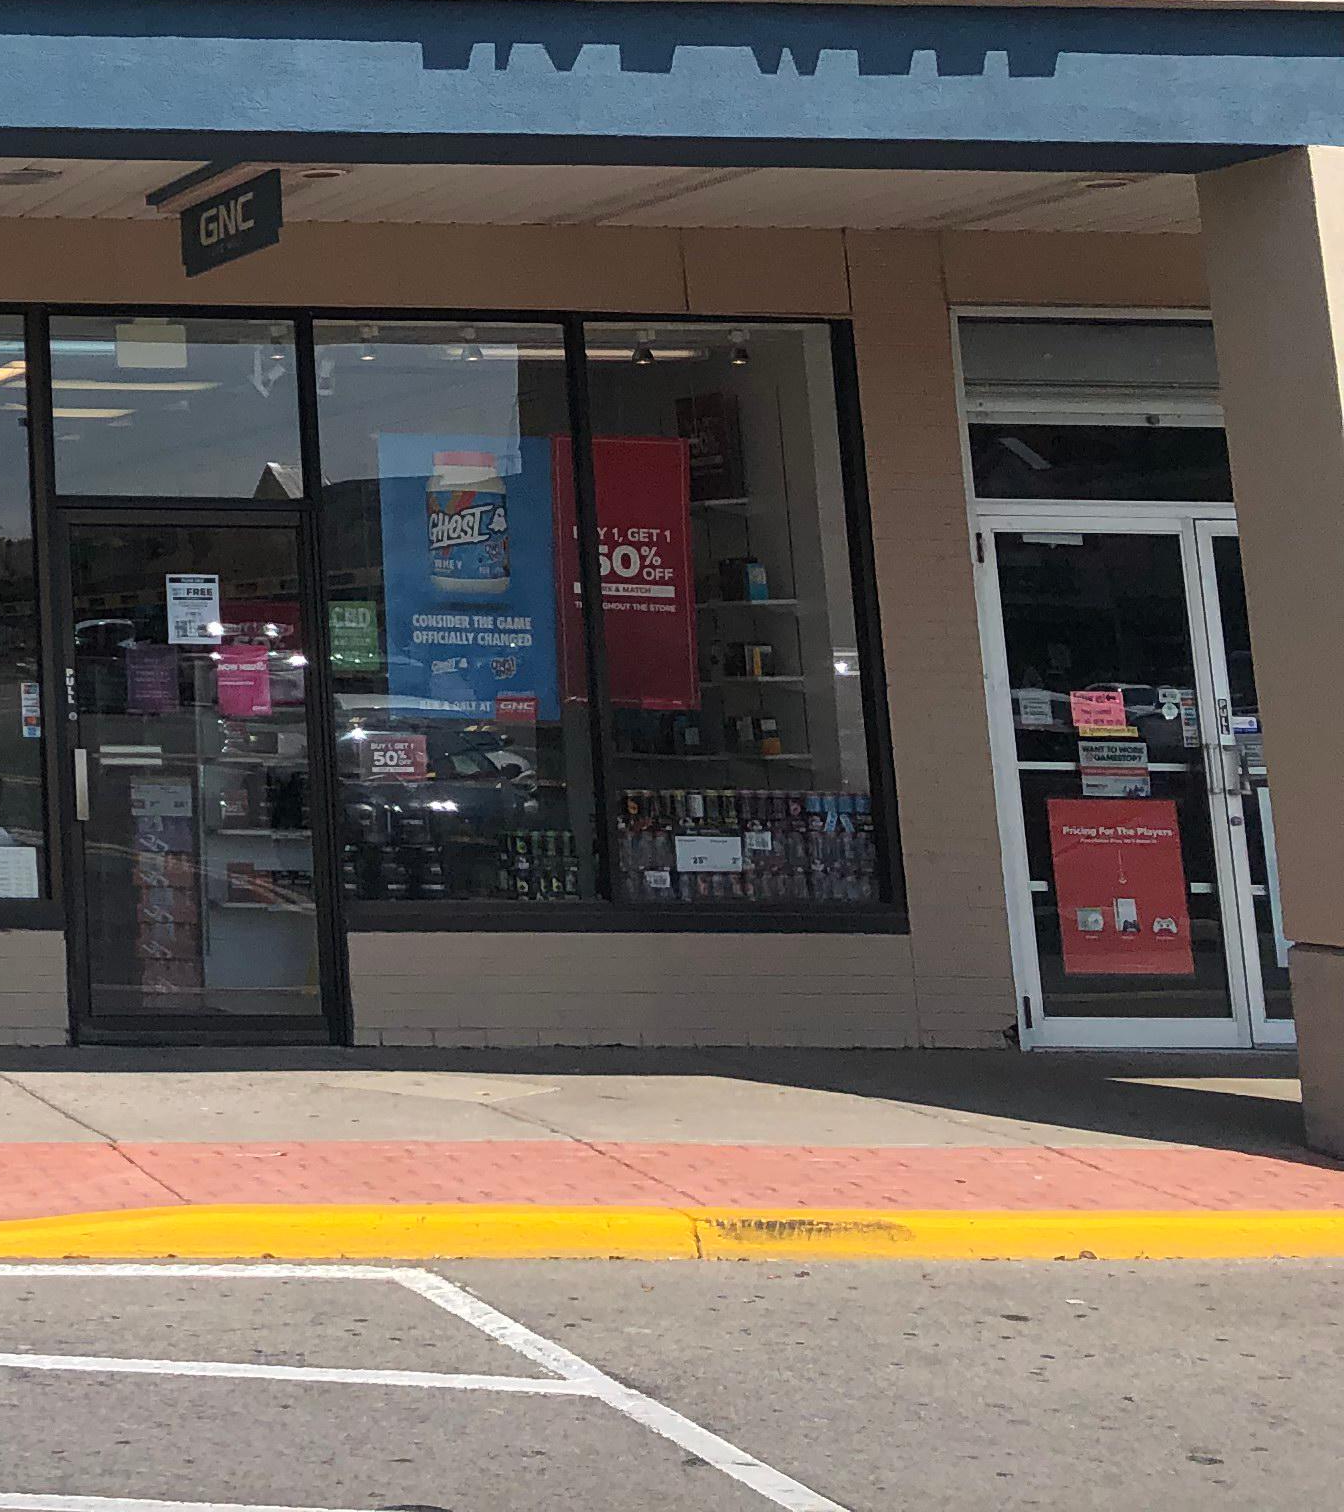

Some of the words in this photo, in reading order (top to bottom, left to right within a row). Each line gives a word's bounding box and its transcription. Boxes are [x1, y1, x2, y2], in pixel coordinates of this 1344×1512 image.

[200, 191, 255, 246] GNC
[429, 504, 493, 548] GHOST
[627, 528, 660, 542] GET
[664, 530, 671, 542] 1
[642, 568, 674, 580] OFF
[186, 588, 213, 596] FREE
[633, 603, 648, 611] THE
[649, 604, 676, 612] STORE
[329, 606, 371, 628] CBD
[412, 614, 470, 628] CONSIDER
[472, 615, 494, 629] THE
[496, 616, 532, 630] GAME
[413, 630, 475, 645] OFFICIALLY
[477, 632, 532, 647] CHANGED
[65, 668, 75, 704] PULL
[500, 701, 535, 710] GNC
[370, 742, 386, 750] BUY
[394, 742, 409, 750] GET
[373, 749, 407, 766] 50%
[1063, 826, 1097, 837] Pricing
[1099, 826, 1115, 836] For
[1116, 826, 1135, 836] The
[1136, 827, 1172, 838] Players
